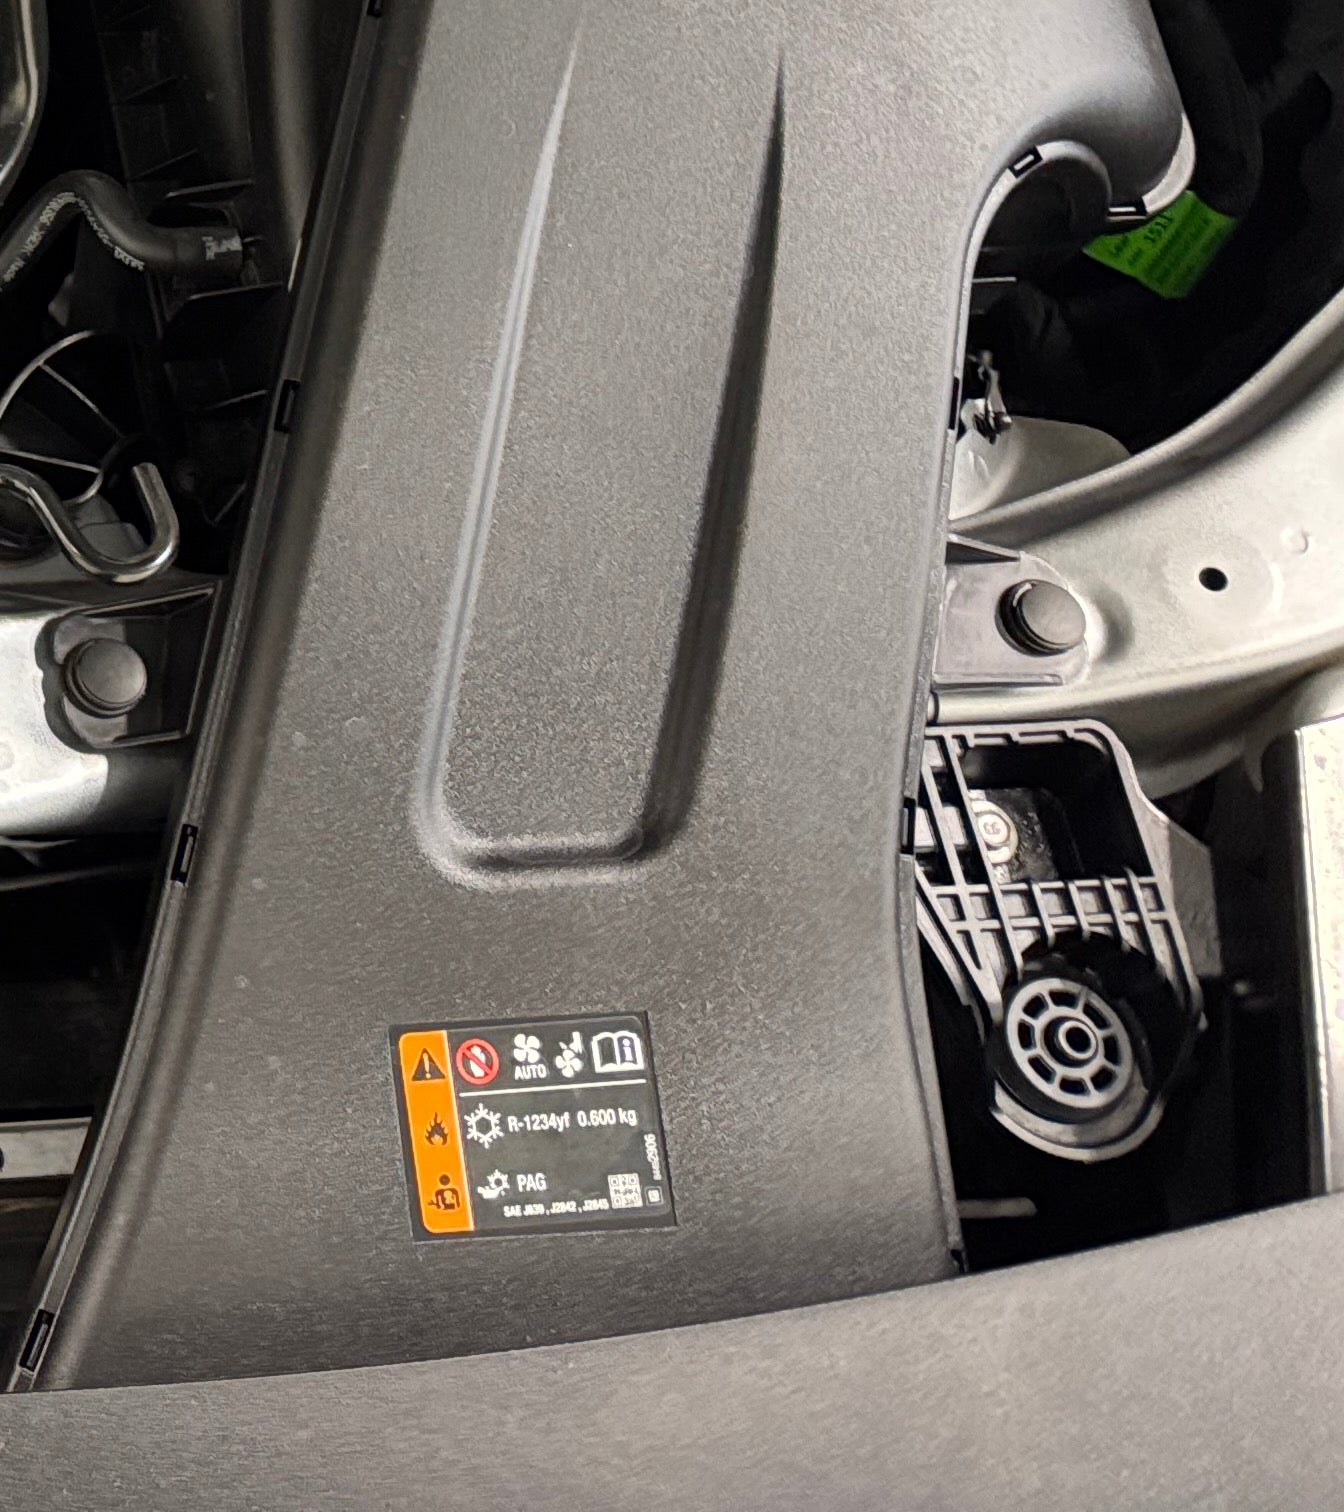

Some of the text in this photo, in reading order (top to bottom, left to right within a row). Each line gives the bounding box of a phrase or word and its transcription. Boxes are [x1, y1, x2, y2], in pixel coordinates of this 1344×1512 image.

[513, 1063, 548, 1081] AUTO
[507, 1107, 638, 1134] R-1234yf 0.600 kg
[516, 1173, 547, 1193] PAG
[503, 1204, 523, 1218] SAE
